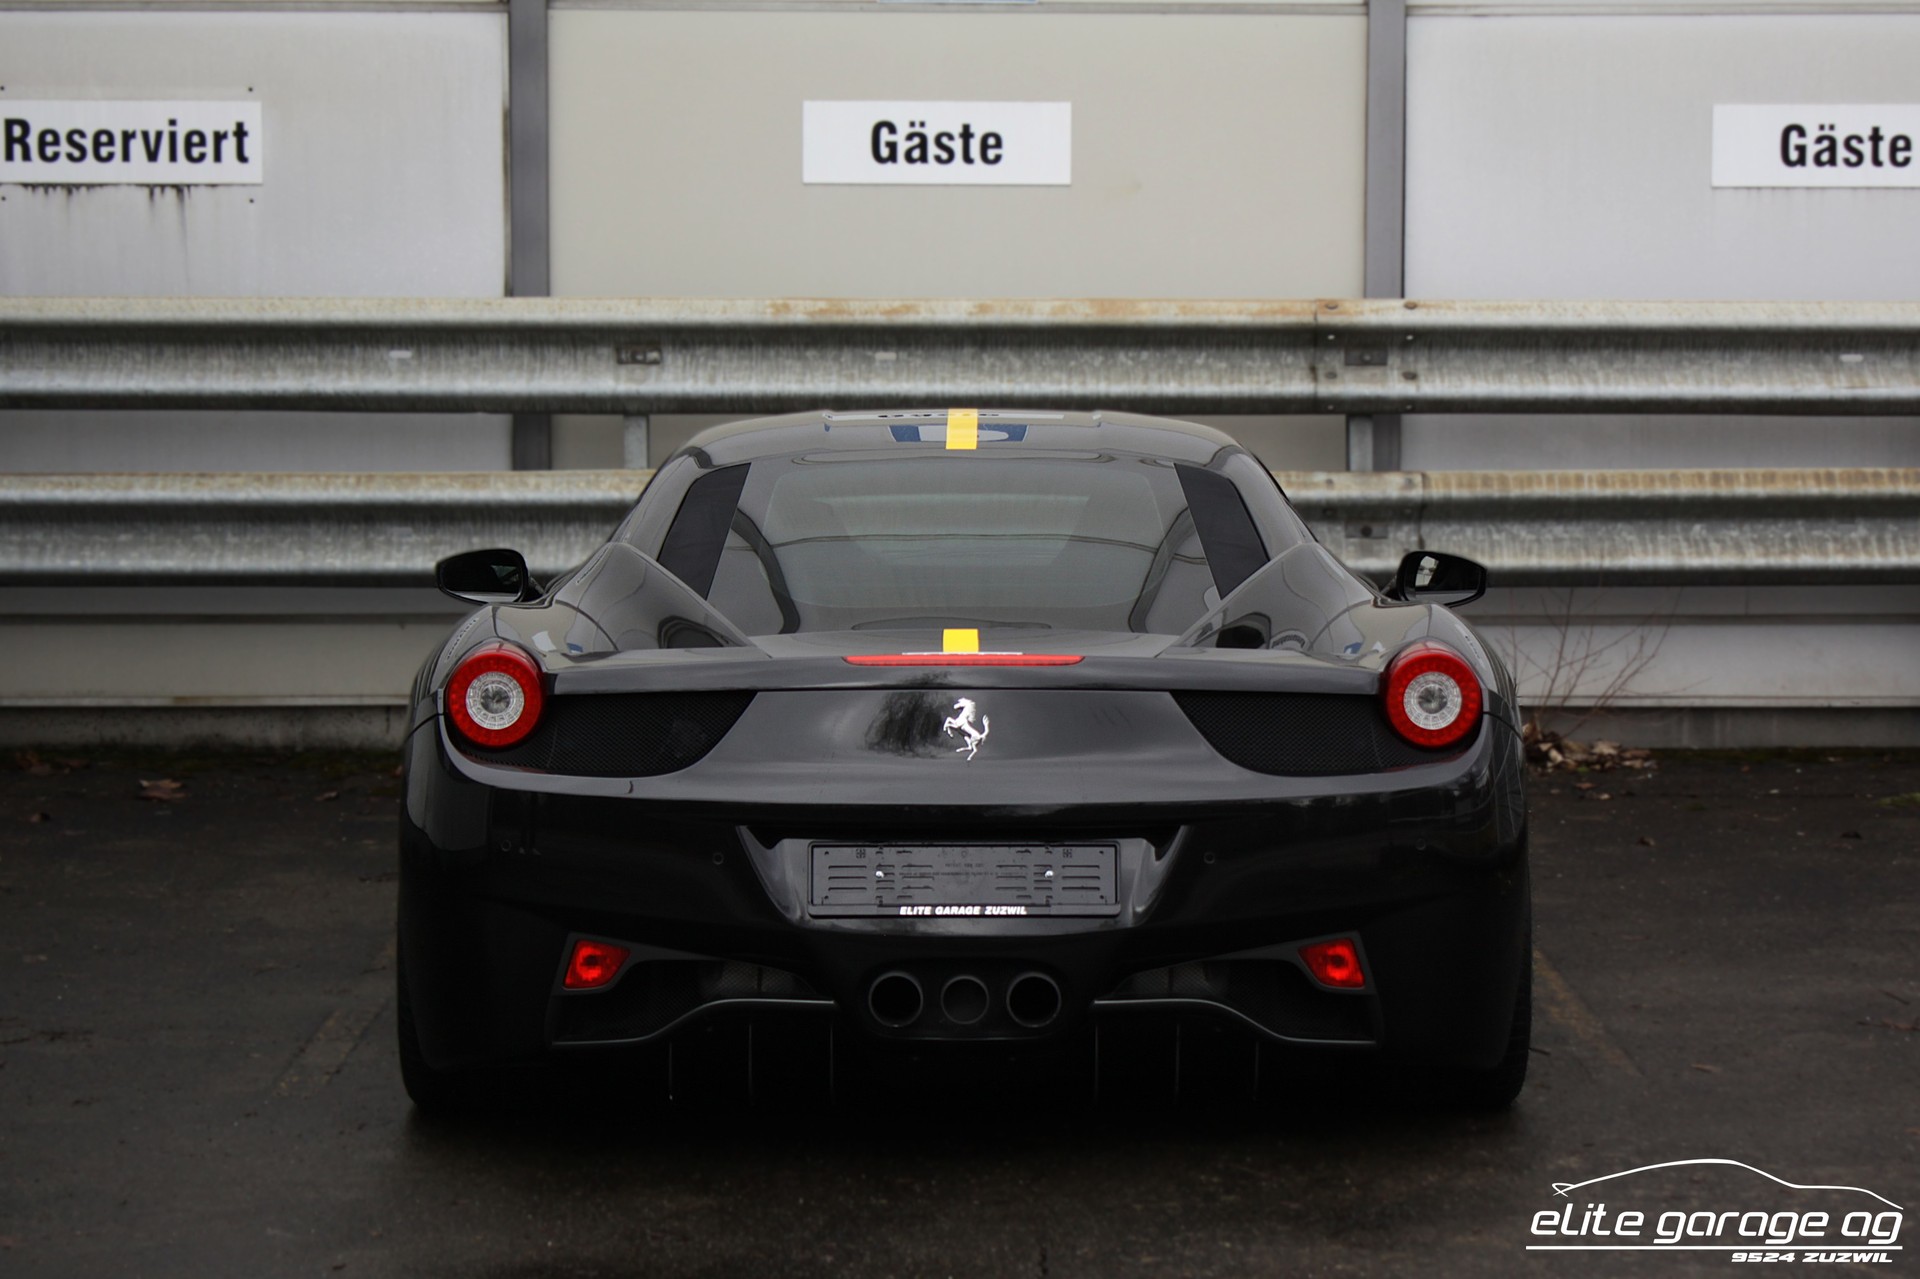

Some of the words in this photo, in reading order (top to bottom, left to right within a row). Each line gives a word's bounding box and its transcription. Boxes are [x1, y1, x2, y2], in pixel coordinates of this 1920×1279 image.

[4, 118, 249, 164] Reserviert
[871, 120, 1003, 165] Gäste
[1780, 124, 1912, 168] Gäste
[900, 906, 932, 916] ELITE
[935, 906, 981, 916] GARAGE
[985, 906, 1027, 916] ZUZWIL
